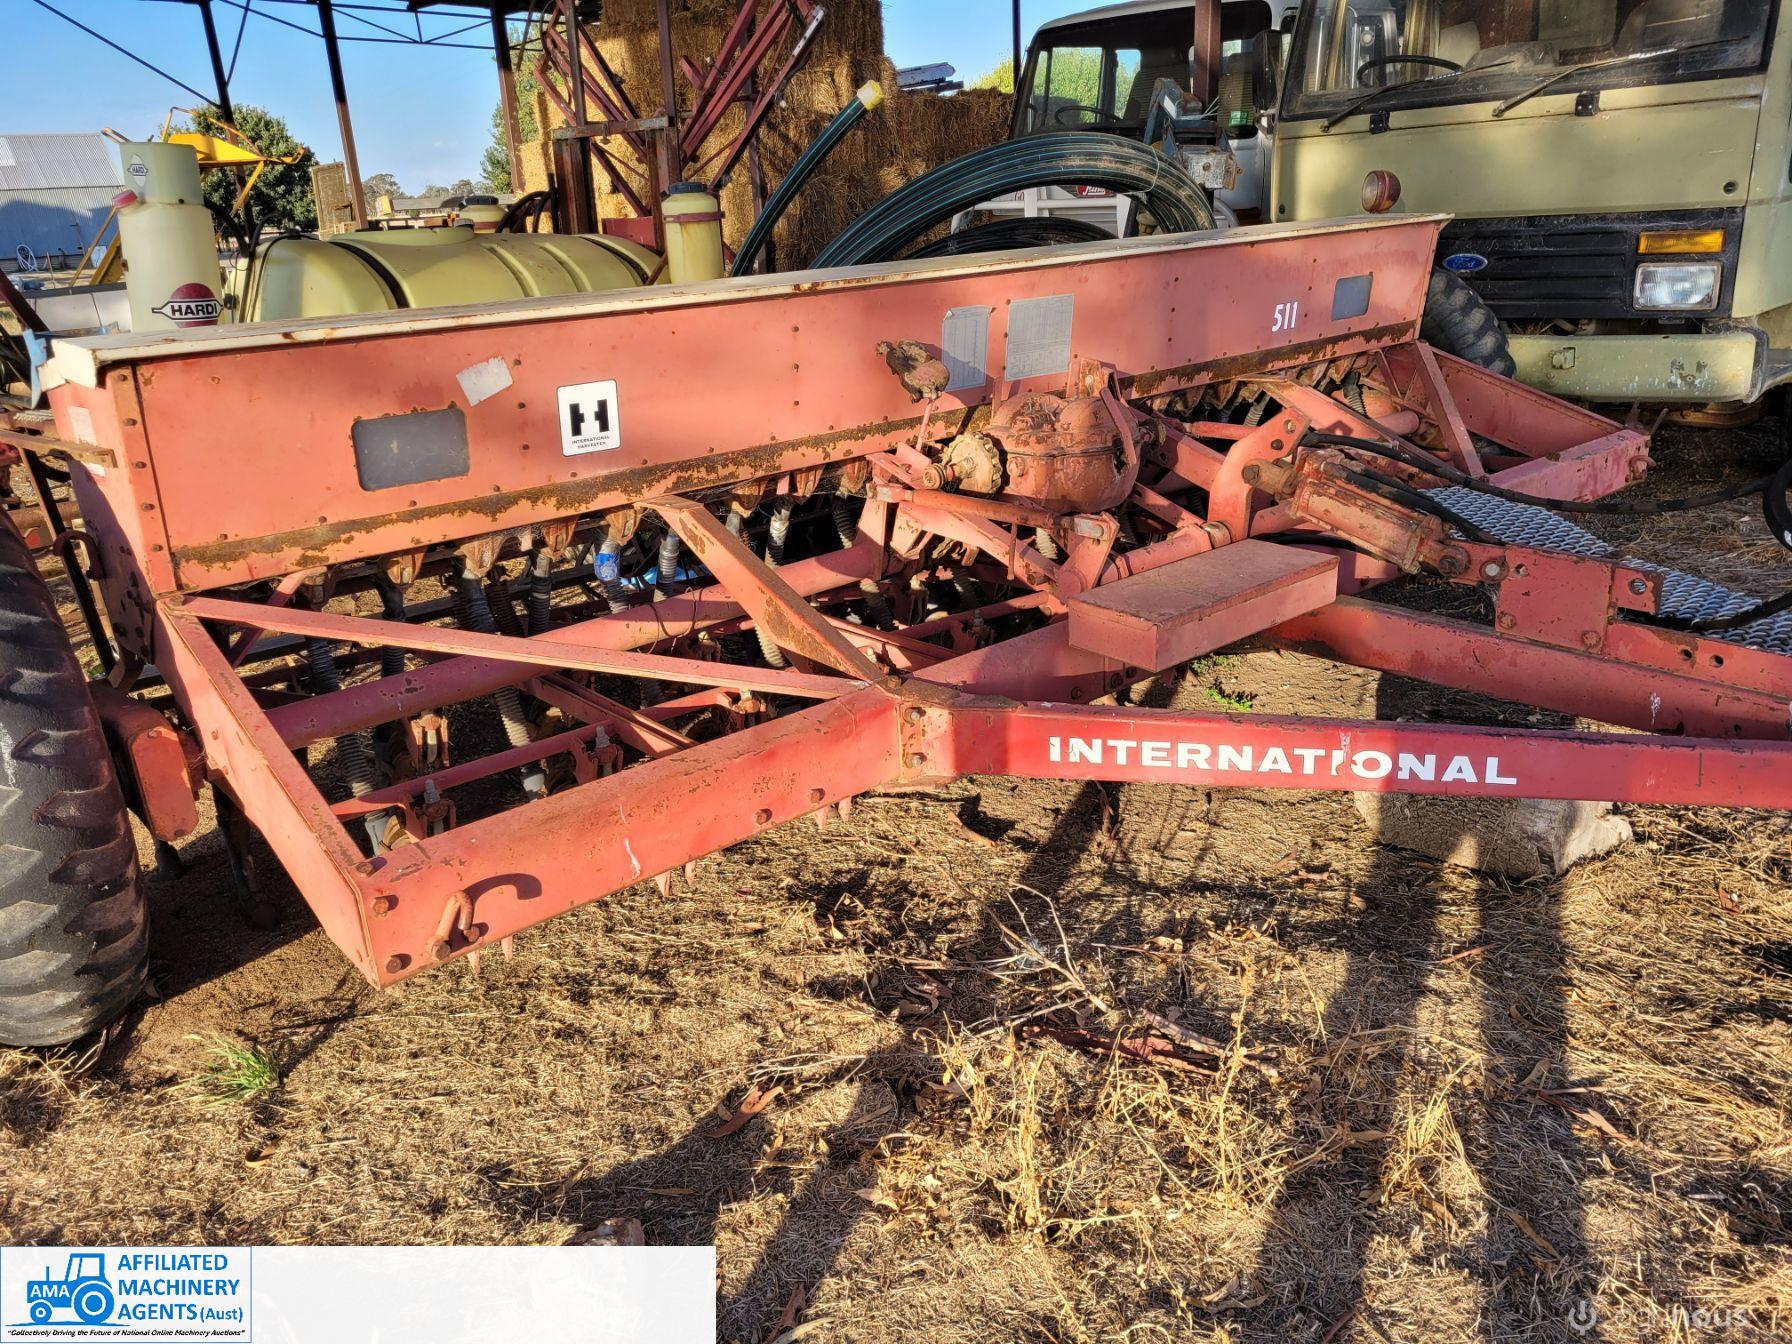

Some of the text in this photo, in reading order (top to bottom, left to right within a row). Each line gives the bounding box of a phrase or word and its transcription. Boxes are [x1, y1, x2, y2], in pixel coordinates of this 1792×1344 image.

[171, 302, 218, 316] HARDI
[1271, 301, 1298, 332] 511
[572, 435, 610, 444] INTERNATIONAL
[1049, 736, 1517, 785] INTERNATIONAL
